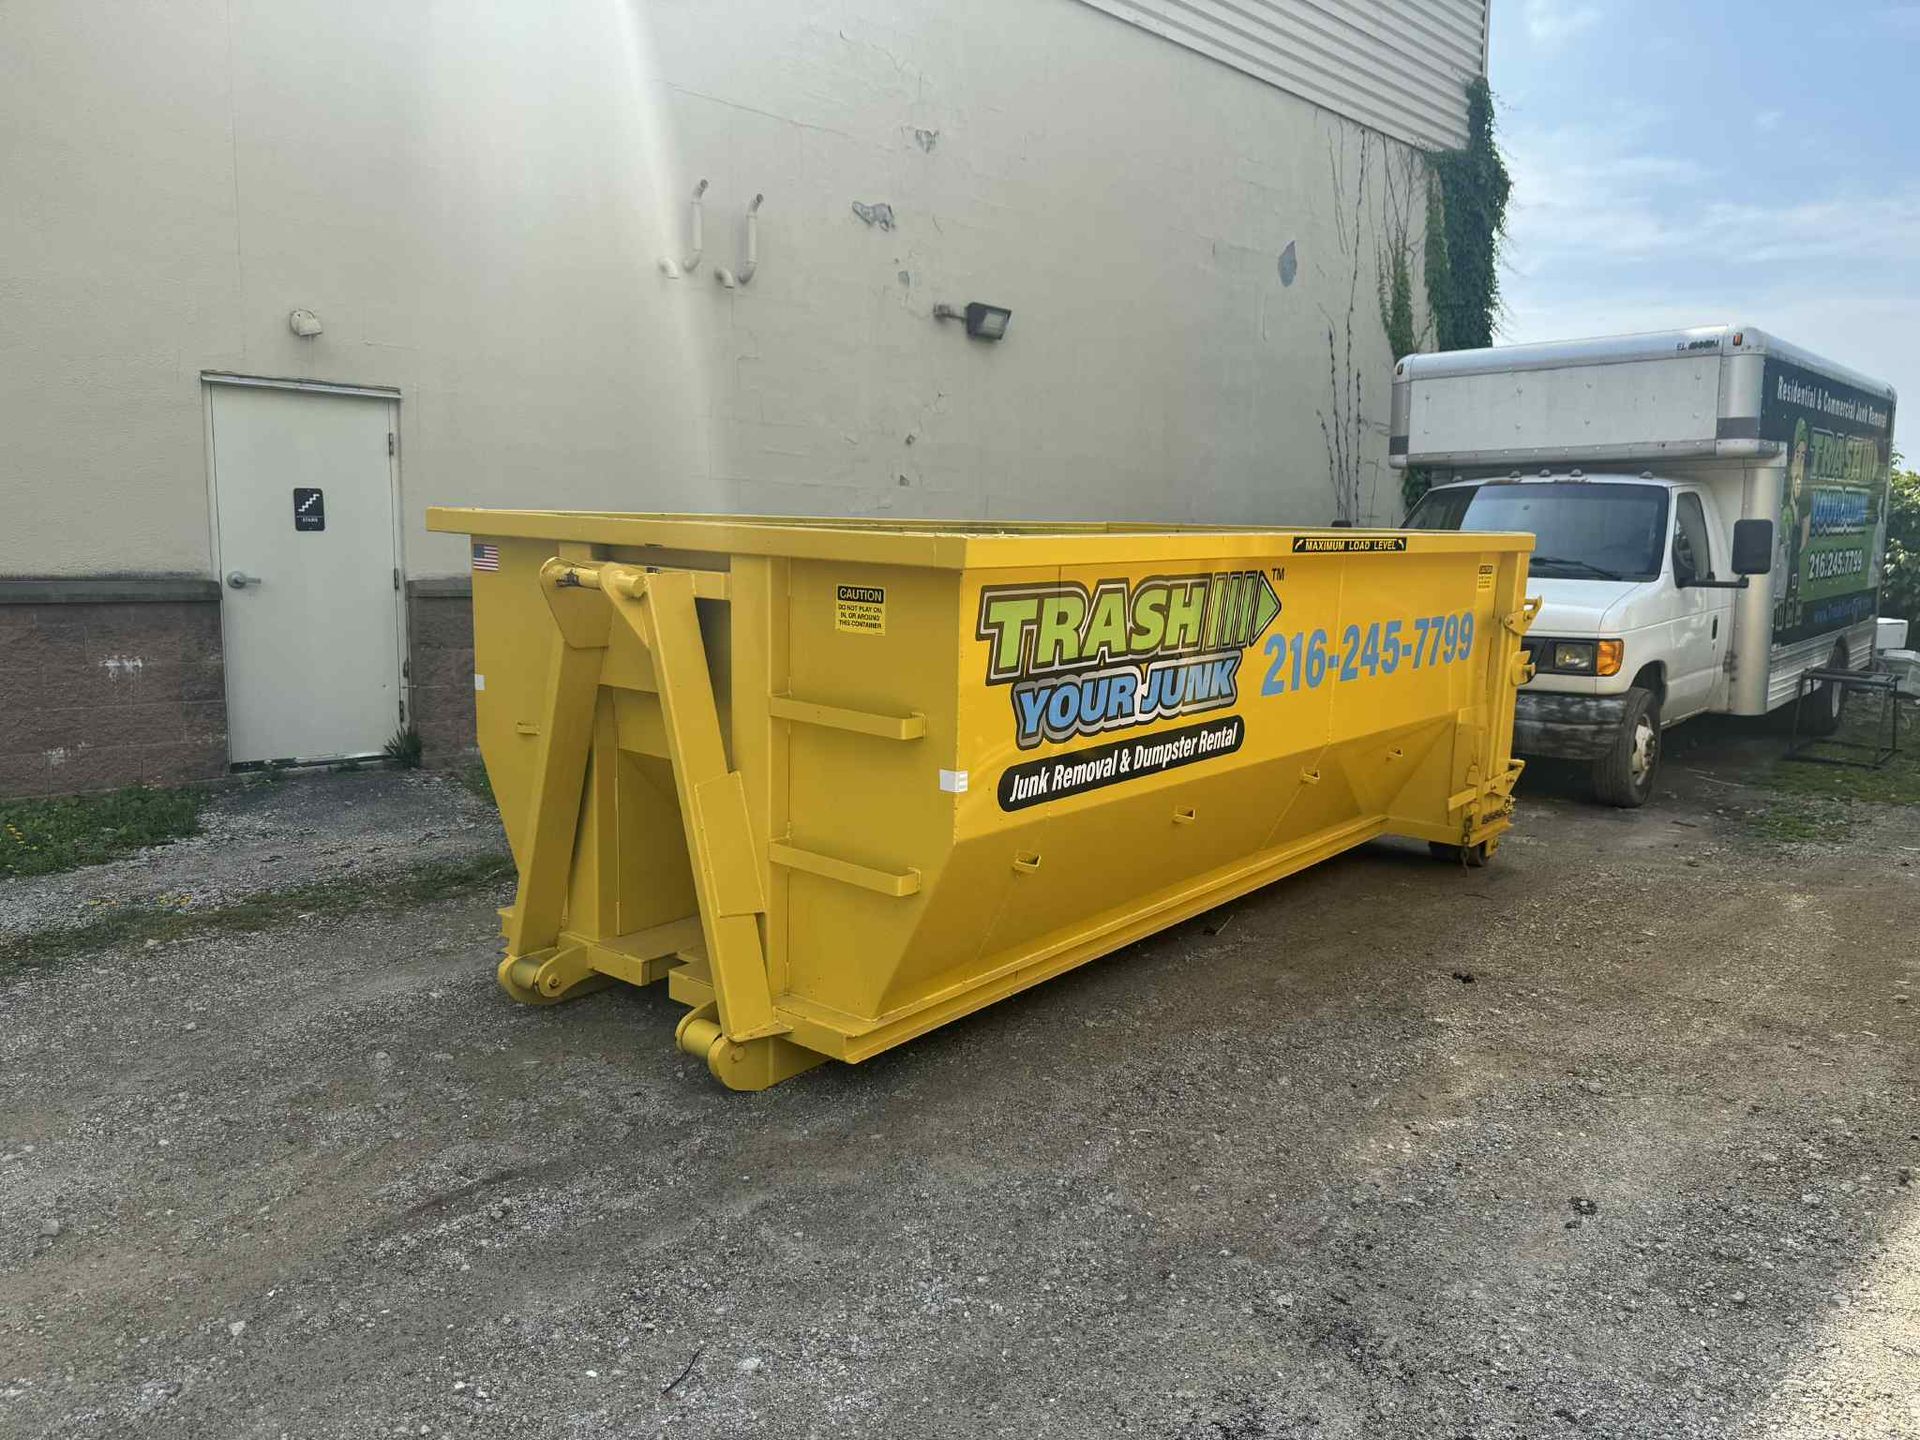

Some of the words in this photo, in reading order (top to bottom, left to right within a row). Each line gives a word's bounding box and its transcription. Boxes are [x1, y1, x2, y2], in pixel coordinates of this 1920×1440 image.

[1777, 375, 1817, 408] Residential
[1823, 390, 1857, 420] Commercial
[1305, 539, 1345, 551] MAXIMUM
[1348, 540, 1371, 551] LOAD
[1373, 540, 1396, 550] LEVEL
[1808, 549, 1863, 580] 216.245.7799
[839, 587, 882, 601] CAUTION
[851, 620, 881, 628] CONTAINER
[983, 580, 1208, 678] TRASH
[1260, 611, 1475, 697] 216-245-7799
[1016, 674, 1138, 735] YOUR
[1140, 657, 1237, 713] JUNK
[1009, 767, 1051, 803] Junk
[1051, 749, 1119, 792] Removal
[1119, 752, 1131, 774] &
[1133, 734, 1198, 769] Dumpster
[1198, 721, 1238, 754] Rental
